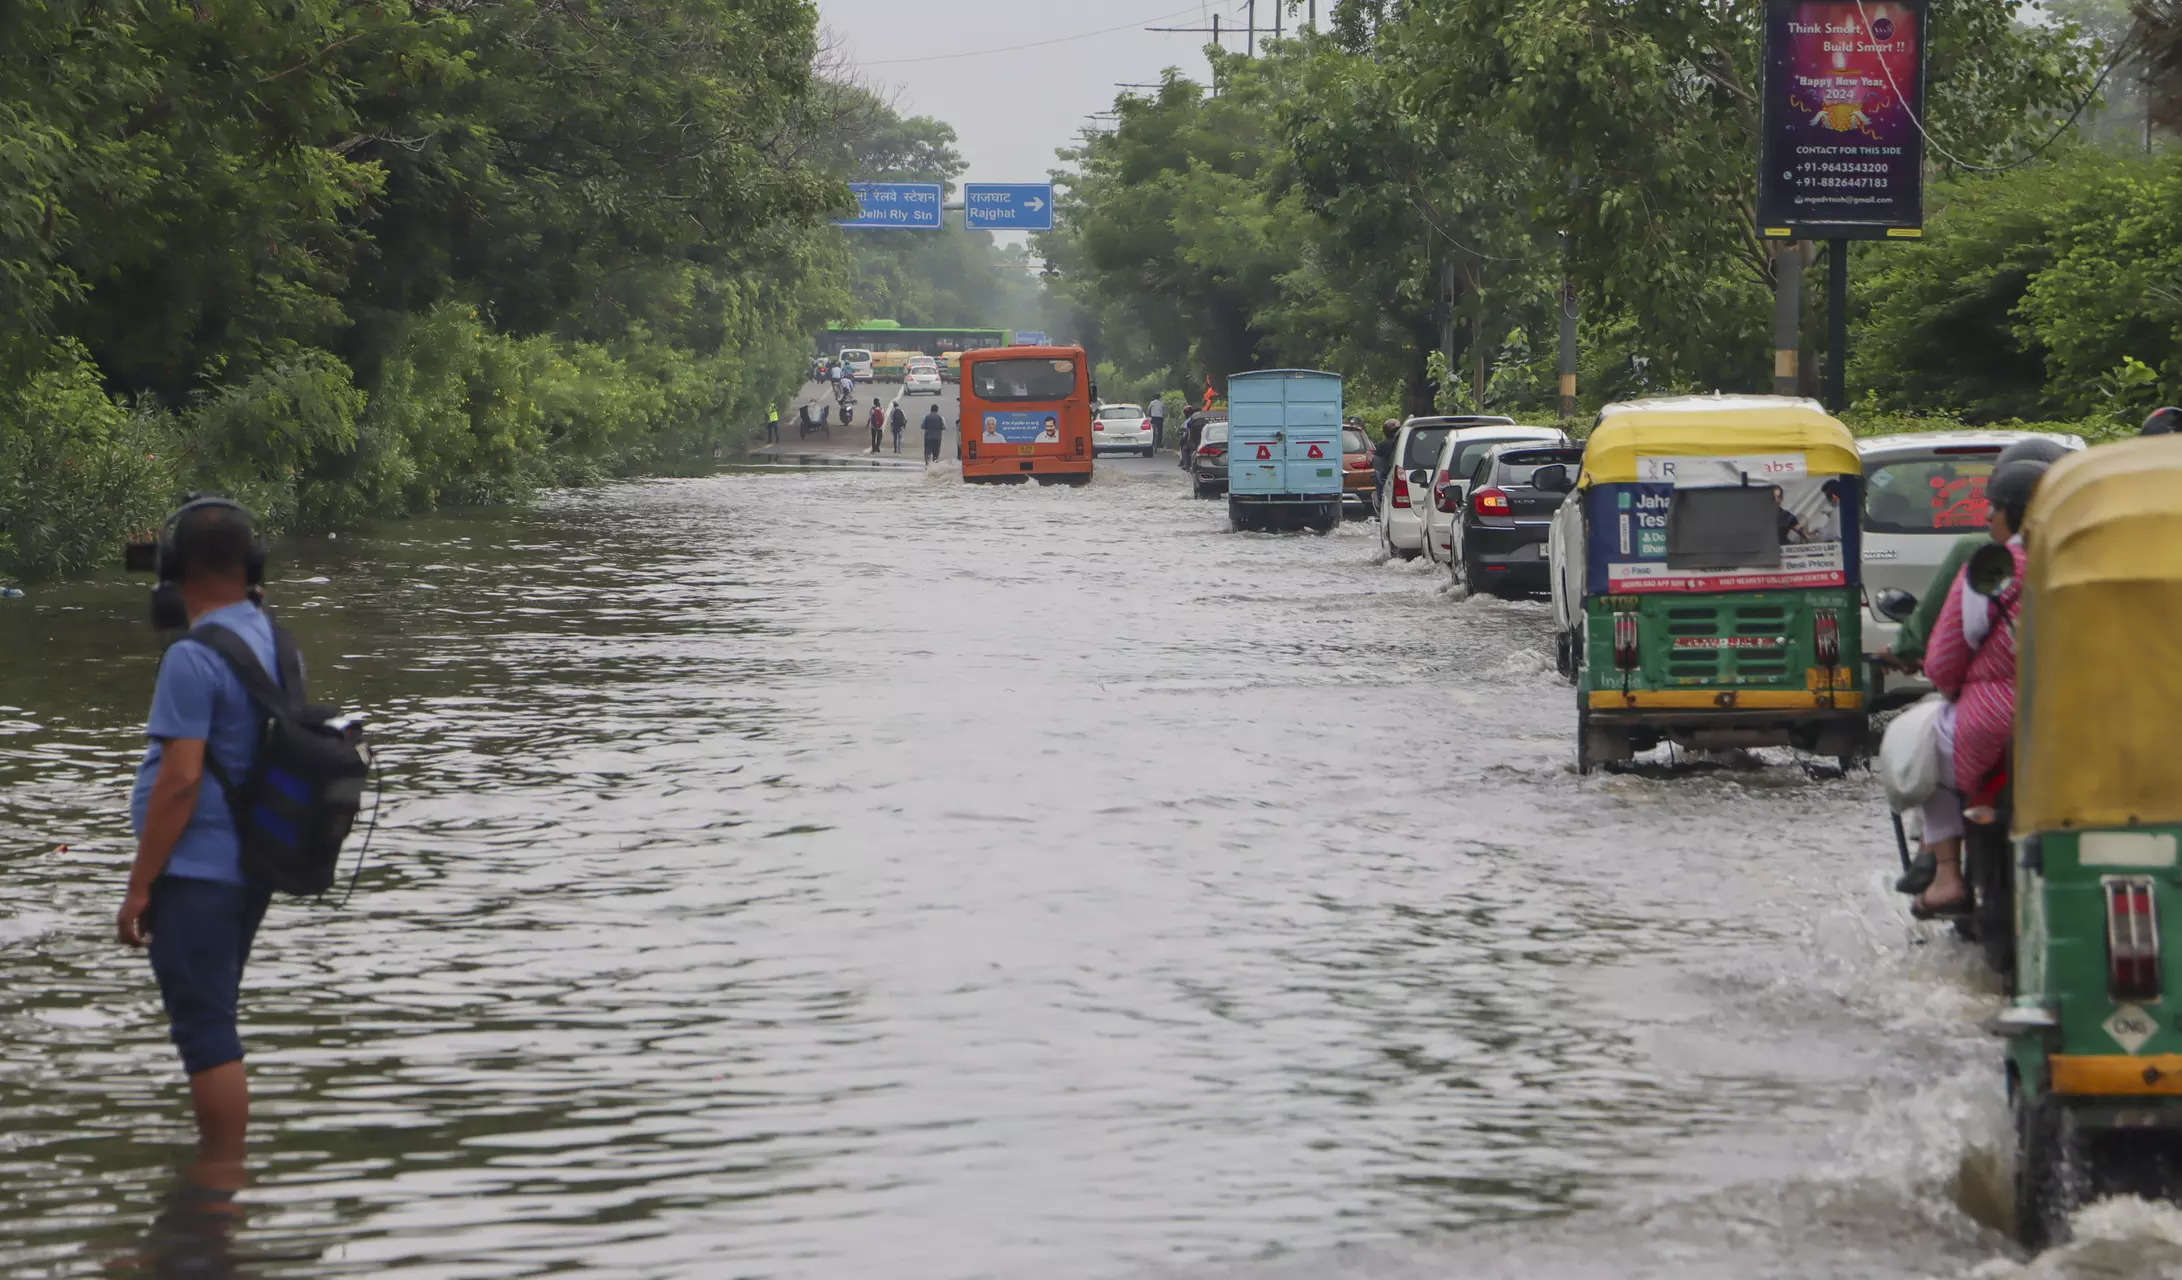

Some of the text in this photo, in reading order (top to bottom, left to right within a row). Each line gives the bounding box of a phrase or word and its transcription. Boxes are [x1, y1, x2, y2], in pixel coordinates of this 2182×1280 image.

[1787, 22, 1821, 33] Think
[1825, 22, 1864, 35] Smart,
[1823, 41, 1905, 52] Build Smart !!
[1799, 76, 1832, 88] Happy
[1835, 77, 1857, 86] New
[1825, 89, 1855, 99] 2024
[1796, 146, 1902, 155] CONTACT FOR THIS SIDE
[1796, 163, 1888, 173] +91-9643543200
[1796, 178, 1888, 188] +91-8826447183
[858, 209, 932, 222] Delhi Rly Stn
[970, 207, 1016, 220] Rajghat
[2113, 1016, 2147, 1035] CNG
